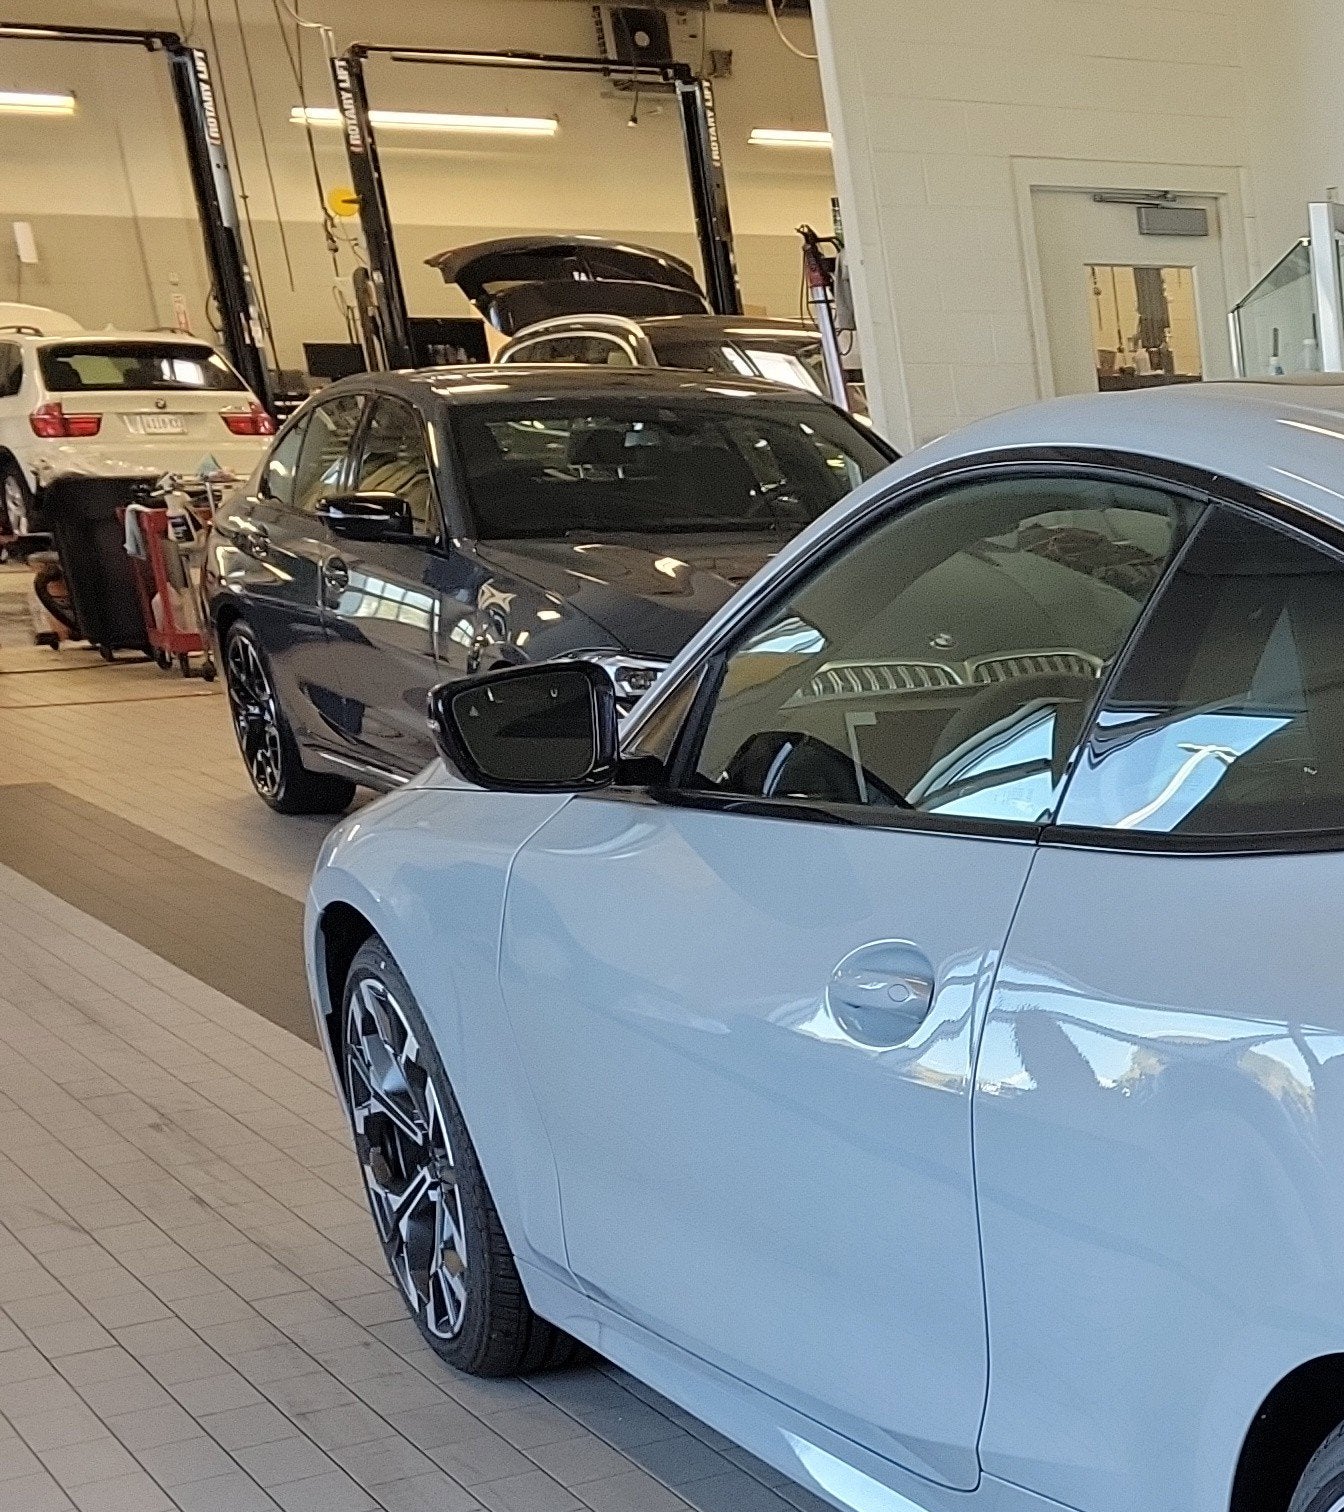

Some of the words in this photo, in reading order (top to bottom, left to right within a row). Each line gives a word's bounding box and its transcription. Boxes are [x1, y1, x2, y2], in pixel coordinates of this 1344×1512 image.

[193, 48, 210, 80] LIFT
[335, 59, 351, 88] LIFT
[199, 81, 221, 138] ROTARY
[702, 80, 713, 107] LIFT
[340, 90, 363, 143] ROTARY
[705, 108, 720, 160] ROTARY
